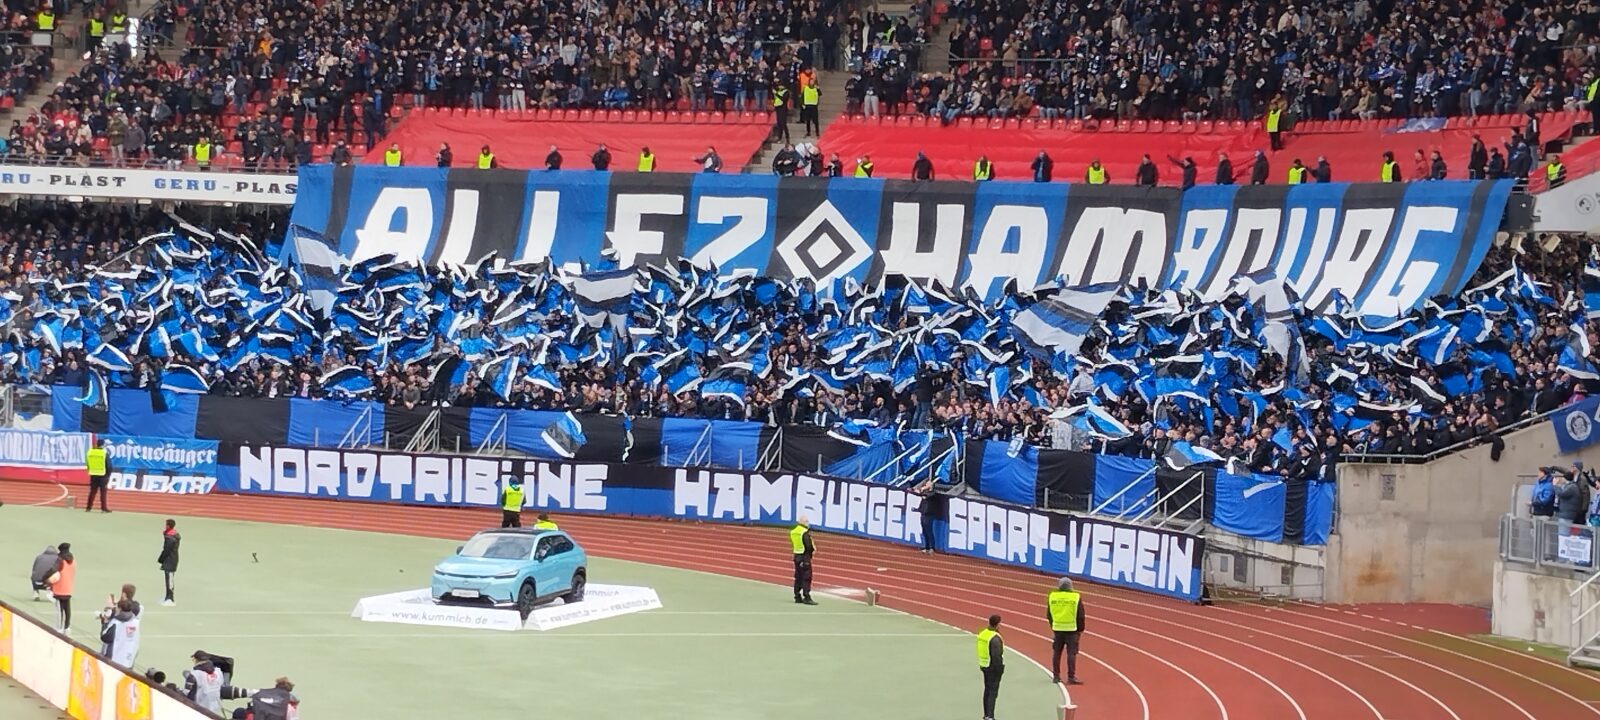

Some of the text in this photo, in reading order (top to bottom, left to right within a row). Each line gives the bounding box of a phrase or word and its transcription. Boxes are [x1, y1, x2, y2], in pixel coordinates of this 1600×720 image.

[674, 468, 922, 544] HAMBURGER
[948, 498, 1194, 594] SPORT-VEREIN
[392, 611, 488, 624] www.kummich.de
